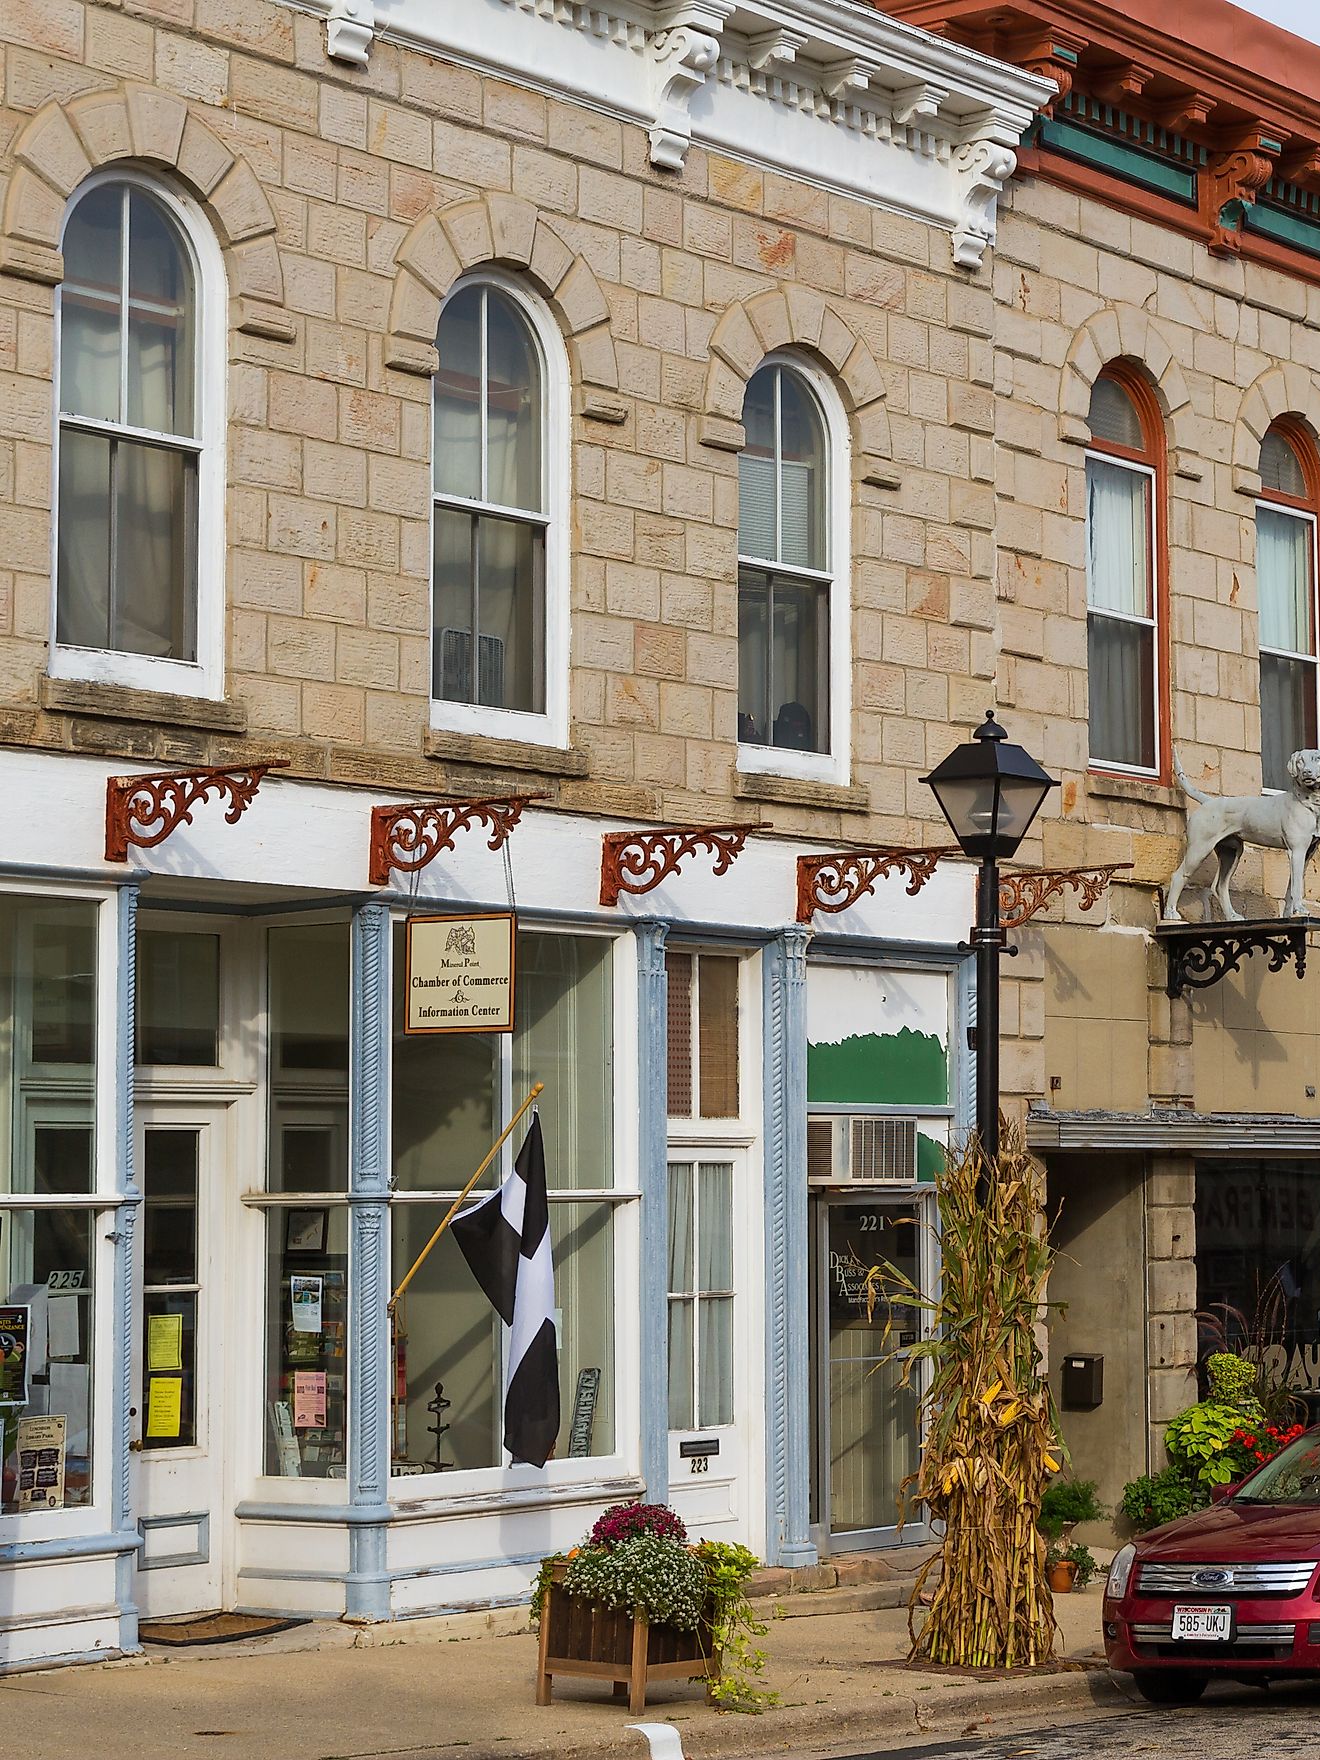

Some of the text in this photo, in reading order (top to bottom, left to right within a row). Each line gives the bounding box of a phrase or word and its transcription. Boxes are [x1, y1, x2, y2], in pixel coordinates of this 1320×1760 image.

[412, 975, 509, 988] Chamber of Commerce
[418, 1004, 501, 1017] Information Center
[859, 1215, 885, 1231] 221
[49, 1271, 82, 1288] 225
[691, 1457, 709, 1474] 223
[1200, 1572, 1220, 1581] Ford
[1179, 1615, 1226, 1632] 585-UKJ
